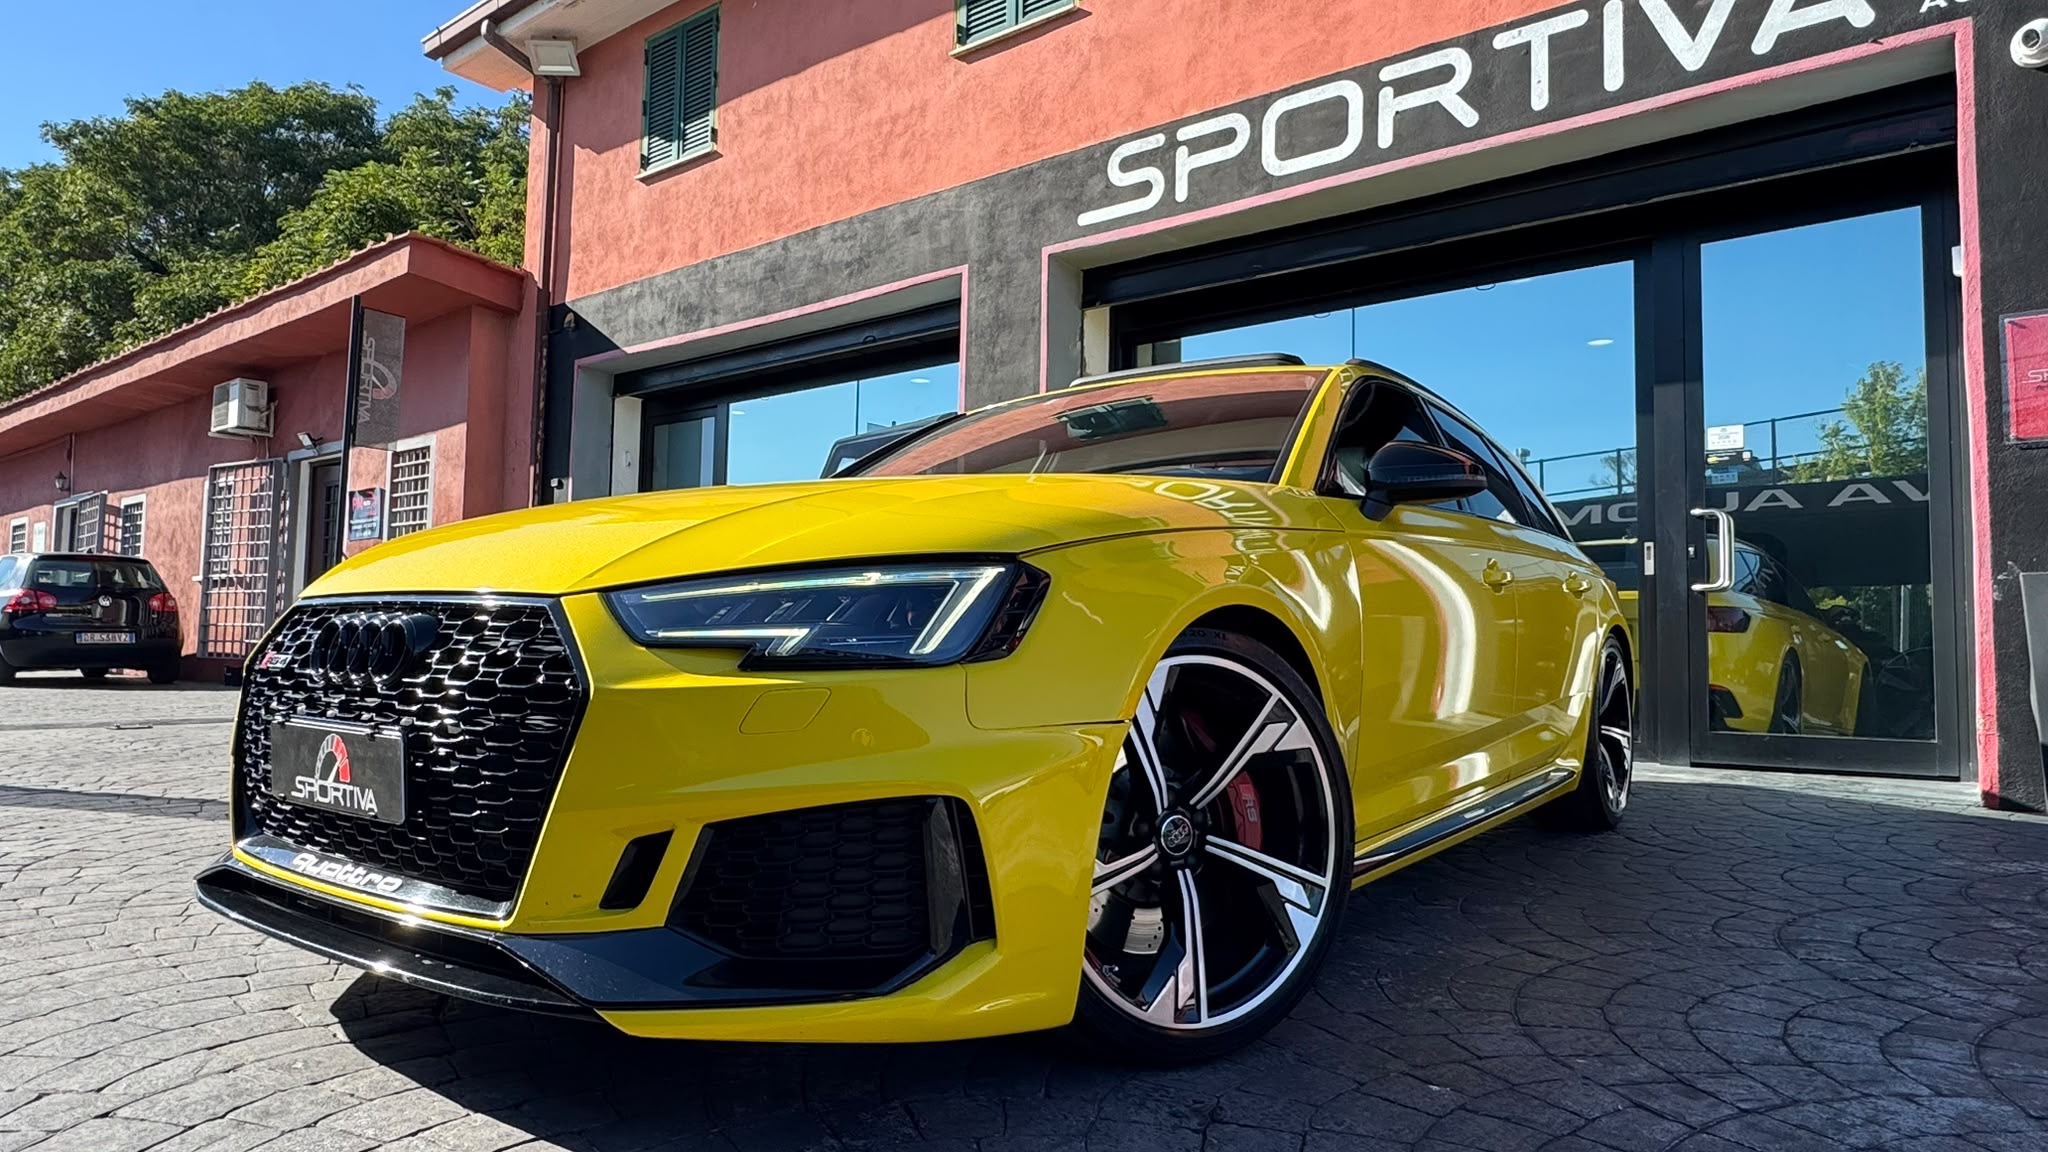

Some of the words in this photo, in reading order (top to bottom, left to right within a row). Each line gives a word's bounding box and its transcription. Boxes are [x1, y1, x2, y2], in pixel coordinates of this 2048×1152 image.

[357, 330, 376, 424] SPORTIVA
[291, 775, 378, 814] SPORTIVA
[292, 852, 403, 892] quattro
